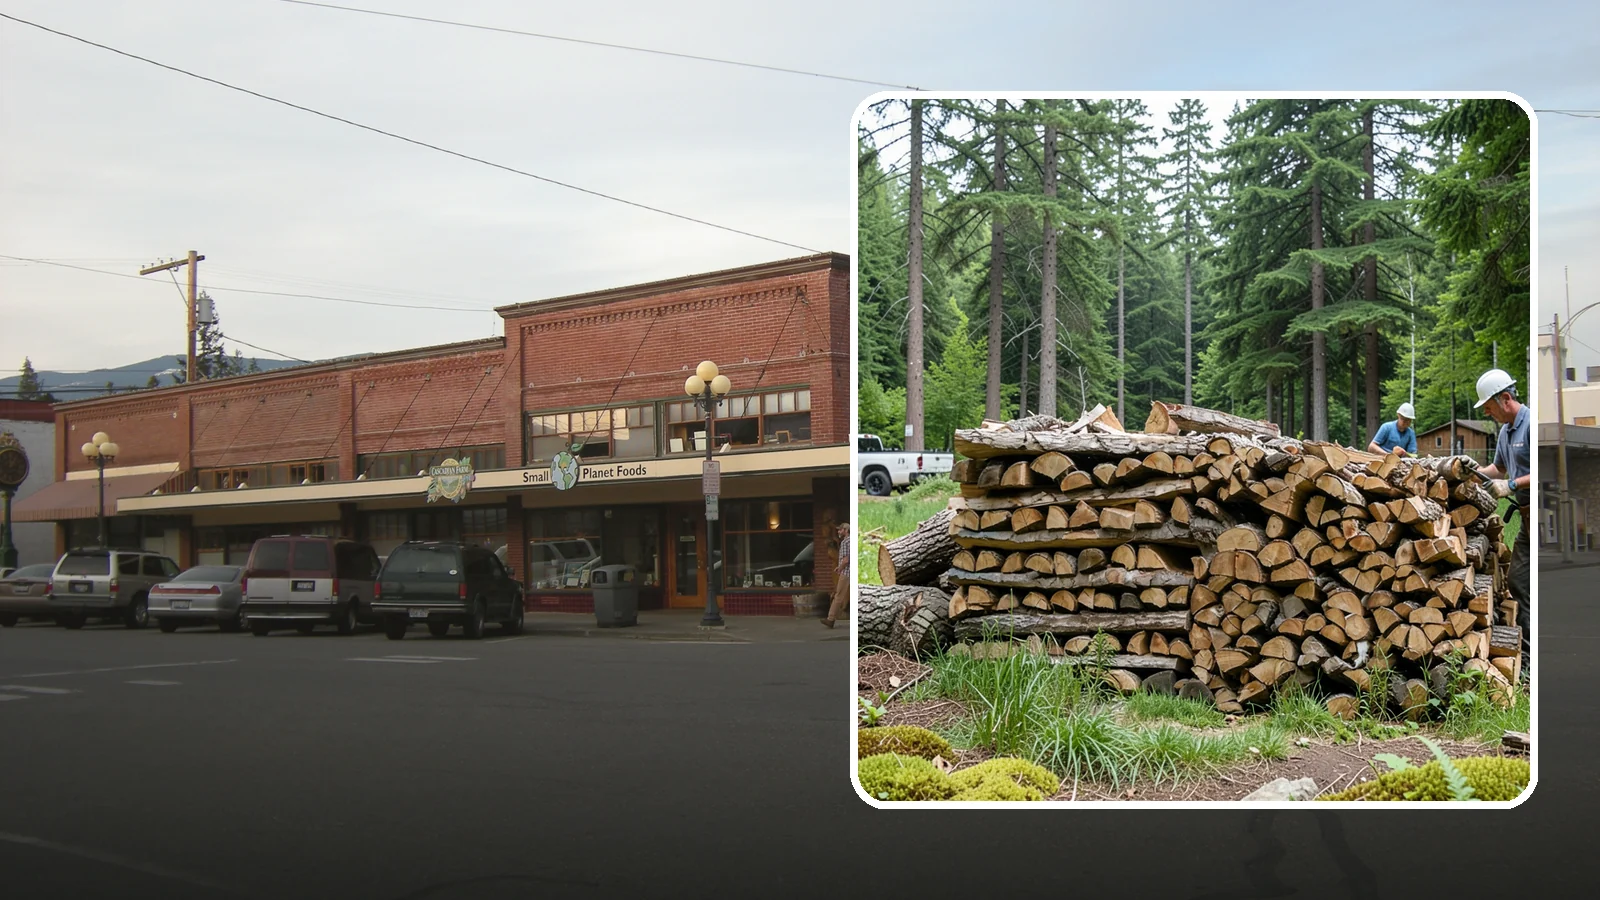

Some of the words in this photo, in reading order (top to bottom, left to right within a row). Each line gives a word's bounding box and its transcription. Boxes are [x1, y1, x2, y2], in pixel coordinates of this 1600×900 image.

[523, 471, 549, 483] Small
[583, 468, 614, 479] Planet
[617, 464, 647, 477] Foods
